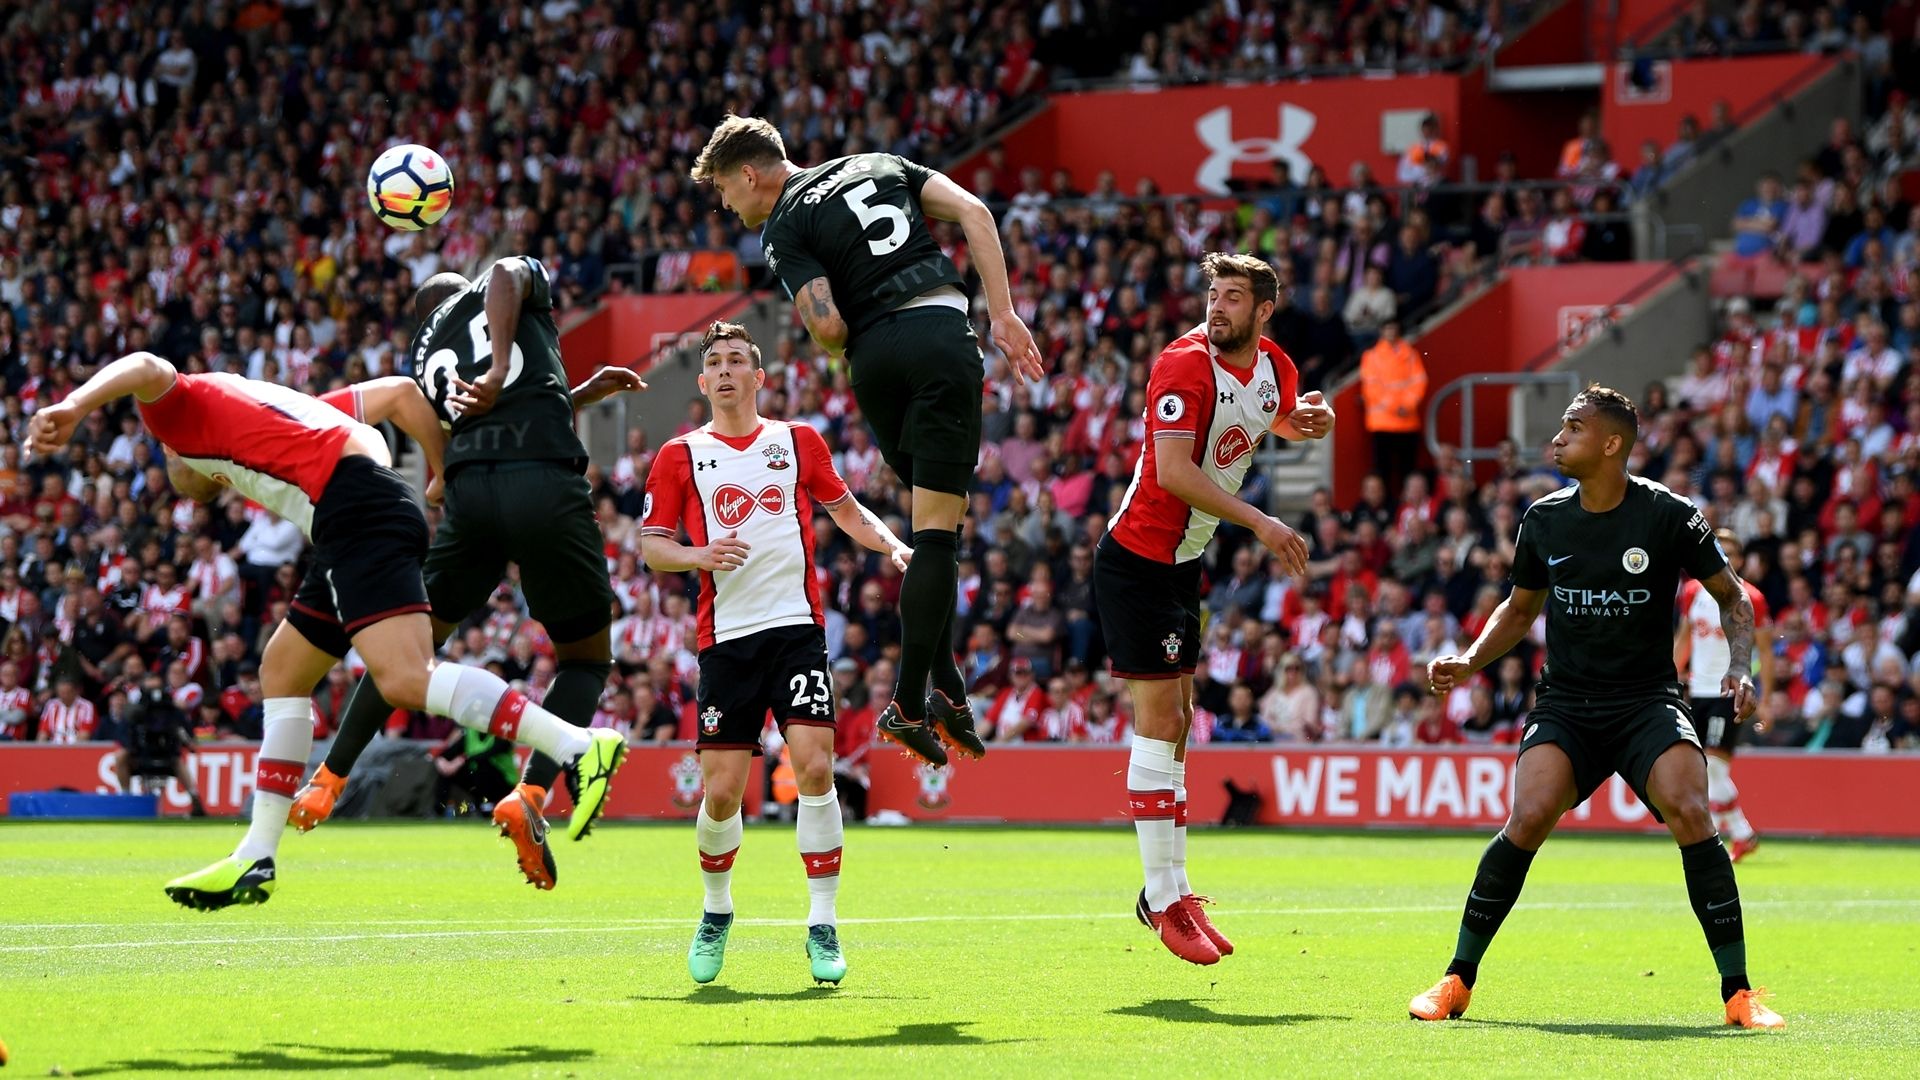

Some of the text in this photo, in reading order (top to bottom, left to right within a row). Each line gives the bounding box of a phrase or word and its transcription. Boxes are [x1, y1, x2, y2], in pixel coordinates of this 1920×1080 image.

[843, 179, 910, 256] 5
[872, 257, 945, 299] CITY
[453, 419, 531, 452] CITY
[1219, 434, 1244, 460] Virgin
[719, 492, 748, 520] Virgin
[760, 495, 782, 504] media
[1554, 585, 1650, 606] ETIHAD
[1566, 606, 1630, 617] AIRWAYS
[790, 669, 830, 707] 23
[259, 769, 300, 788] SAIN
[1272, 756, 1360, 816] WE
[1468, 908, 1493, 921] CITY
[1714, 916, 1739, 925] CITY
